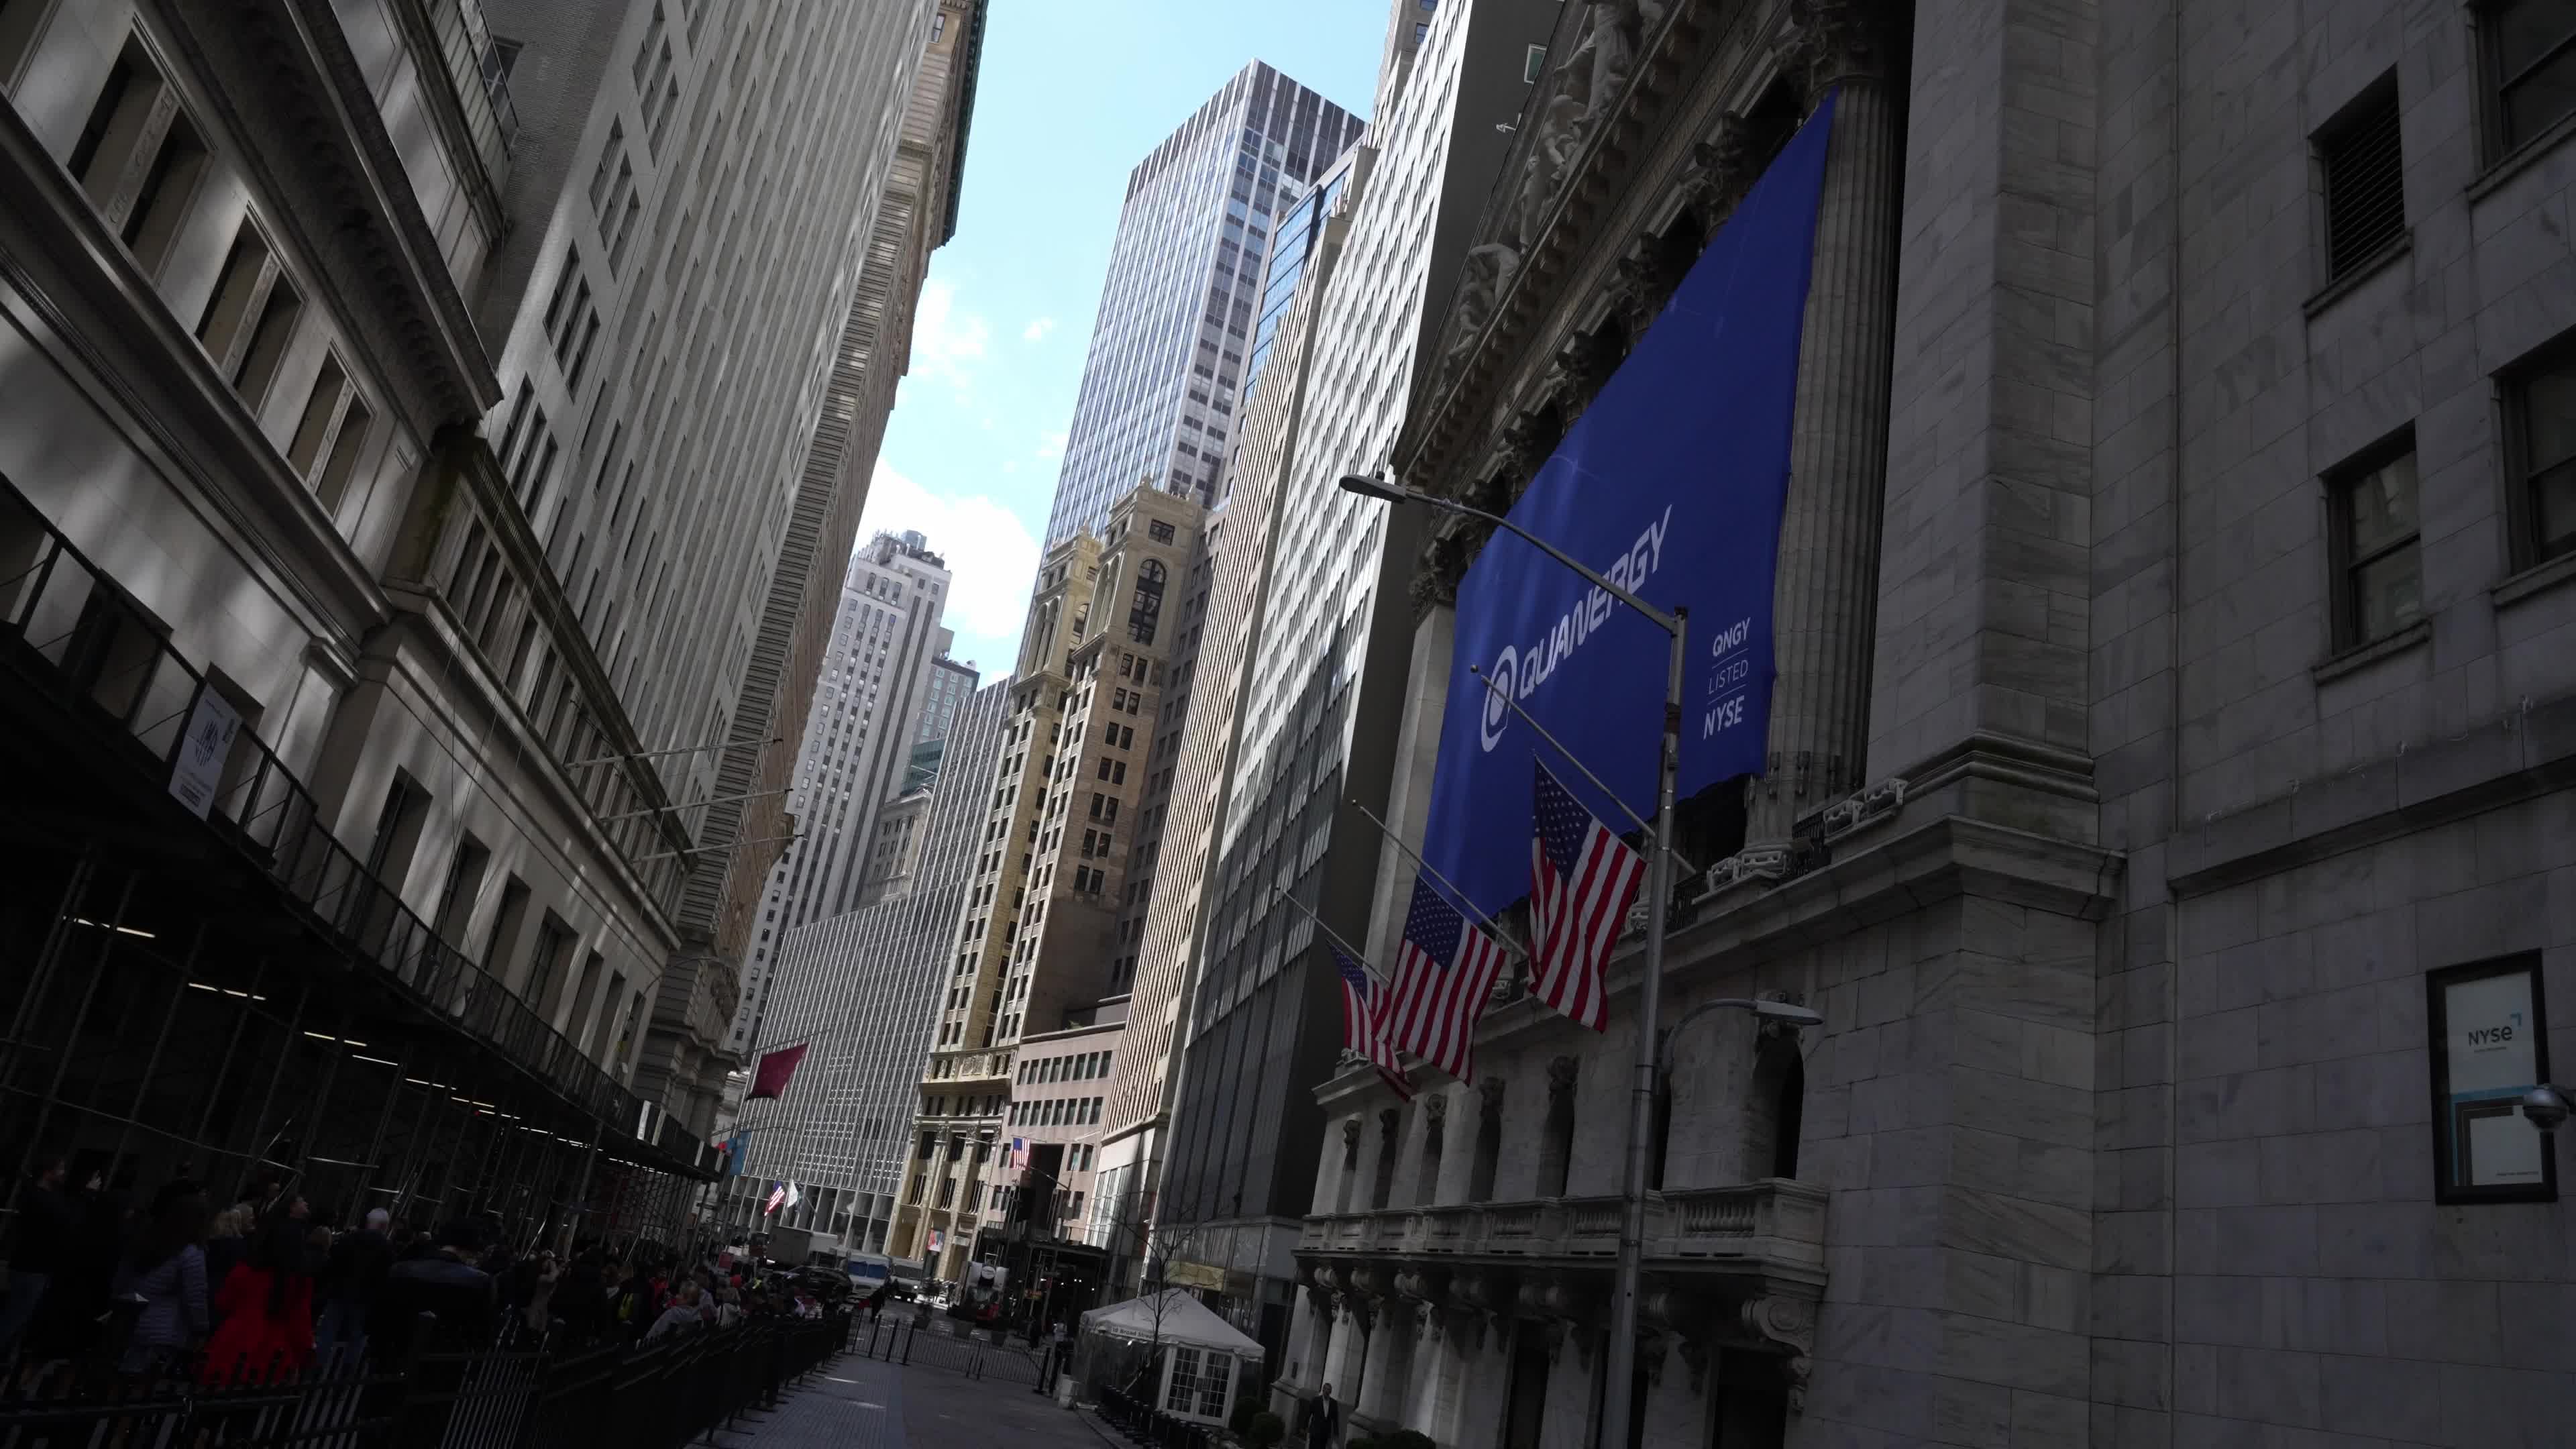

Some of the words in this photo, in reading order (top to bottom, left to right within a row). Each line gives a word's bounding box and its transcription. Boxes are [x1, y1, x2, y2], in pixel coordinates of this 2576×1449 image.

[1519, 504, 1672, 700] QUANERGY
[1713, 616, 1751, 657] QNGY
[1709, 659, 1749, 695] LISTED
[1703, 695, 1745, 741] NYSE
